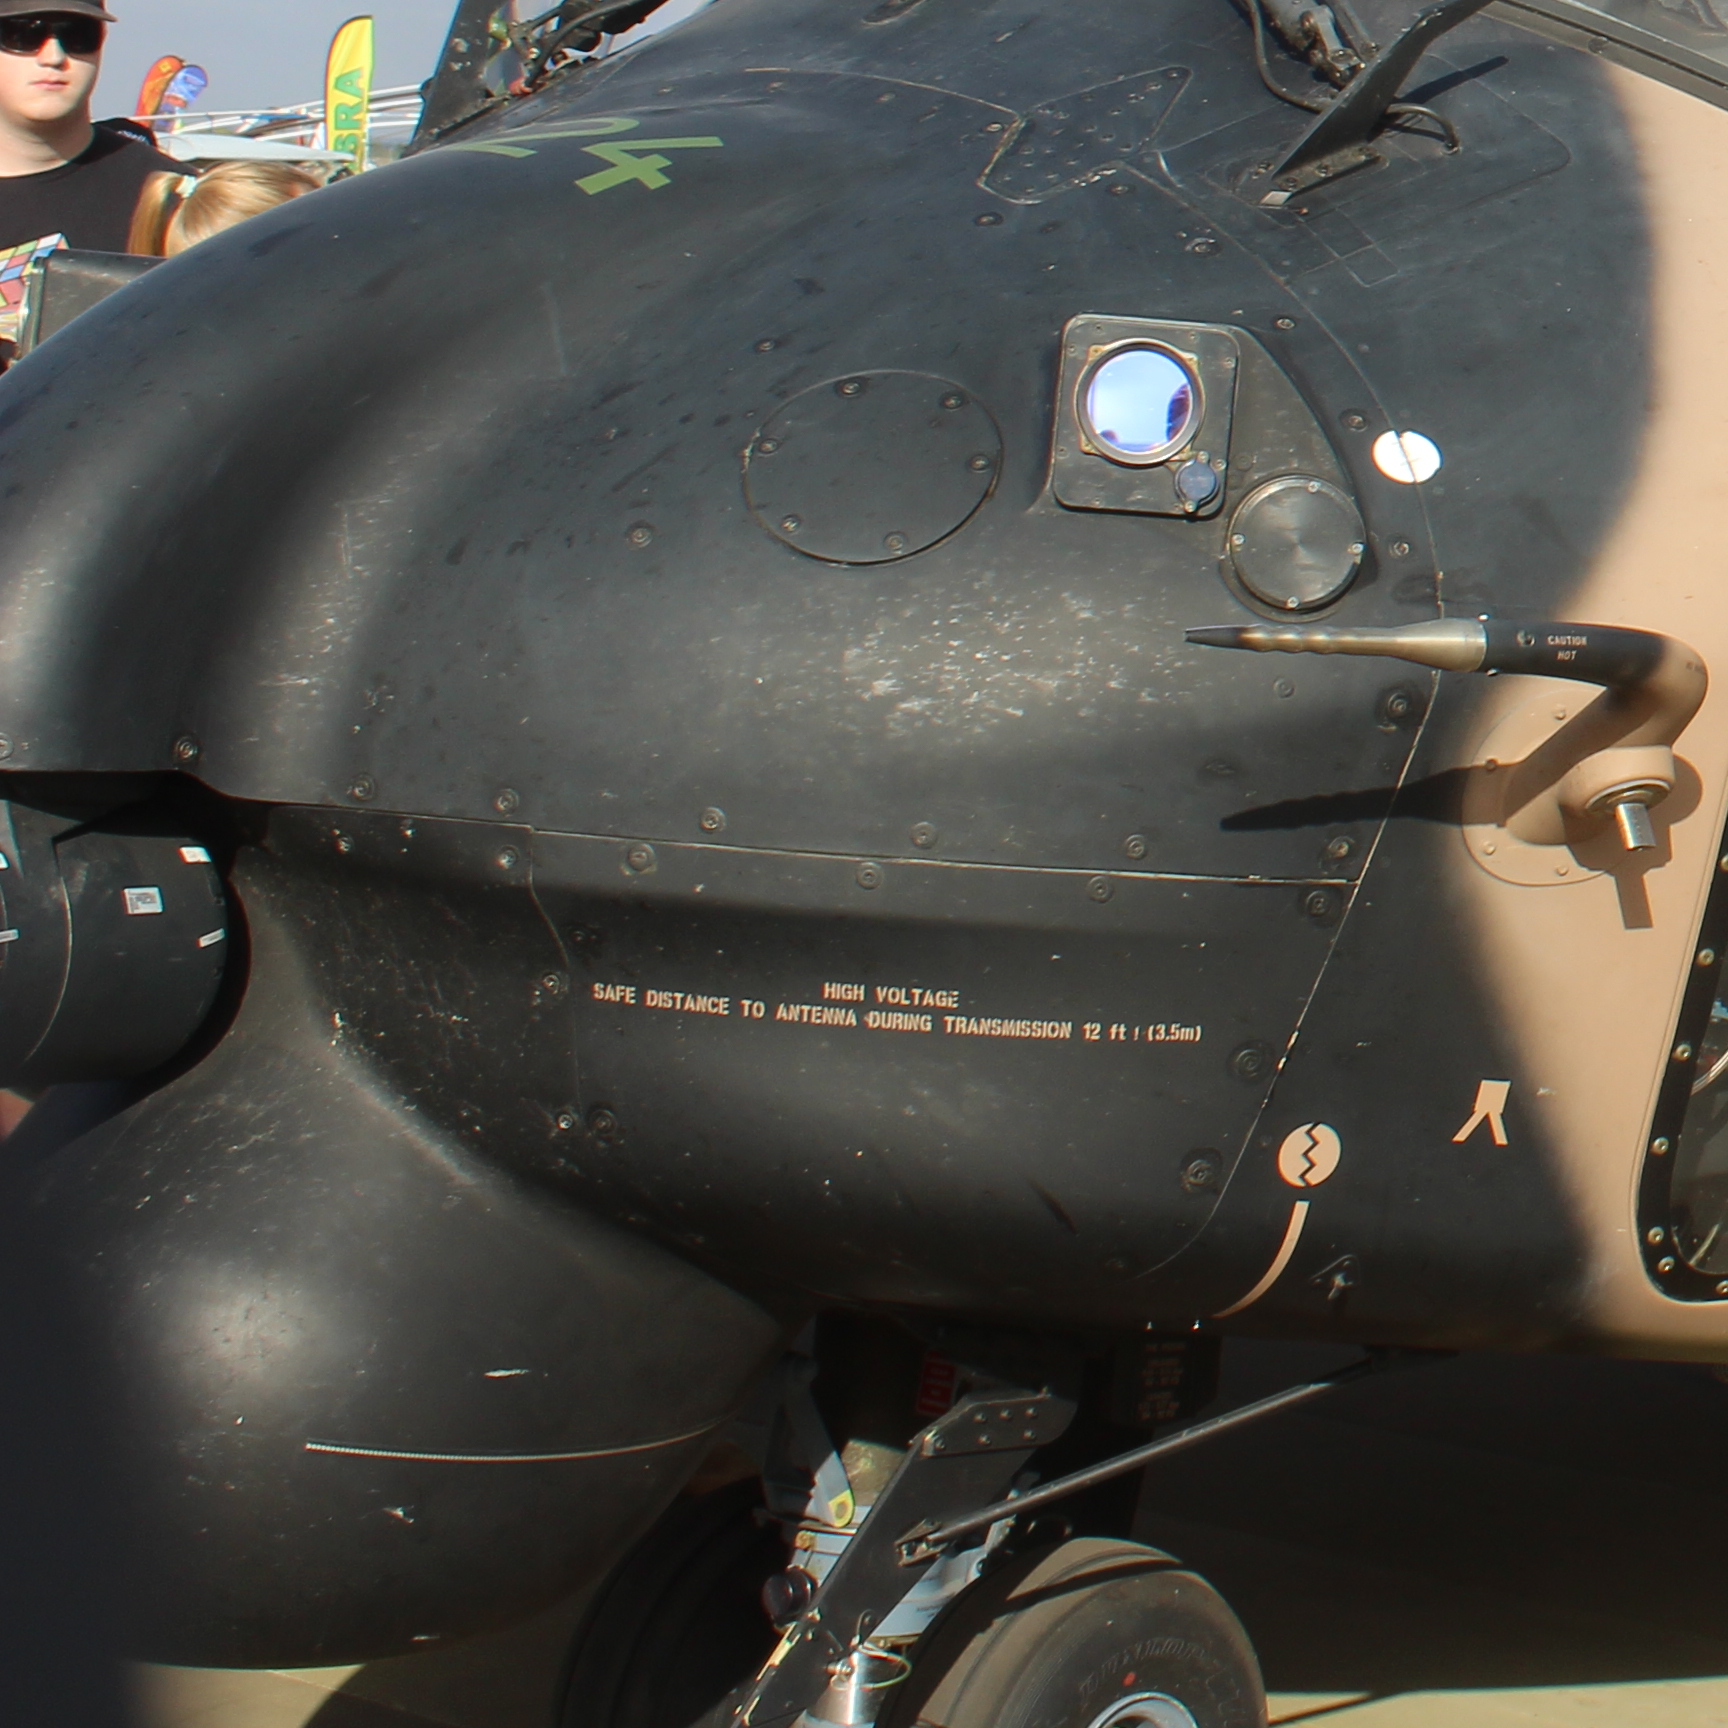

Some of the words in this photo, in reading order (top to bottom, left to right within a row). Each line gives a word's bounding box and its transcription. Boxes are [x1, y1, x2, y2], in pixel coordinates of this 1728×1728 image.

[1547, 635, 1587, 647] CAUTION
[1557, 650, 1577, 661] HOT
[823, 981, 865, 1002] HIGH
[875, 984, 960, 1009] VOLTAGE
[592, 982, 636, 1004] SAFE
[645, 989, 730, 1015] DISTANCE
[740, 999, 766, 1019] TO
[775, 1002, 857, 1027] ANTENNA
[866, 1010, 932, 1033] DURING
[944, 1015, 1072, 1040] TRANSMISSION
[1082, 1022, 1101, 1041] 12
[1109, 1023, 1126, 1041] ft
[1147, 1023, 1203, 1043] (3.5m)
